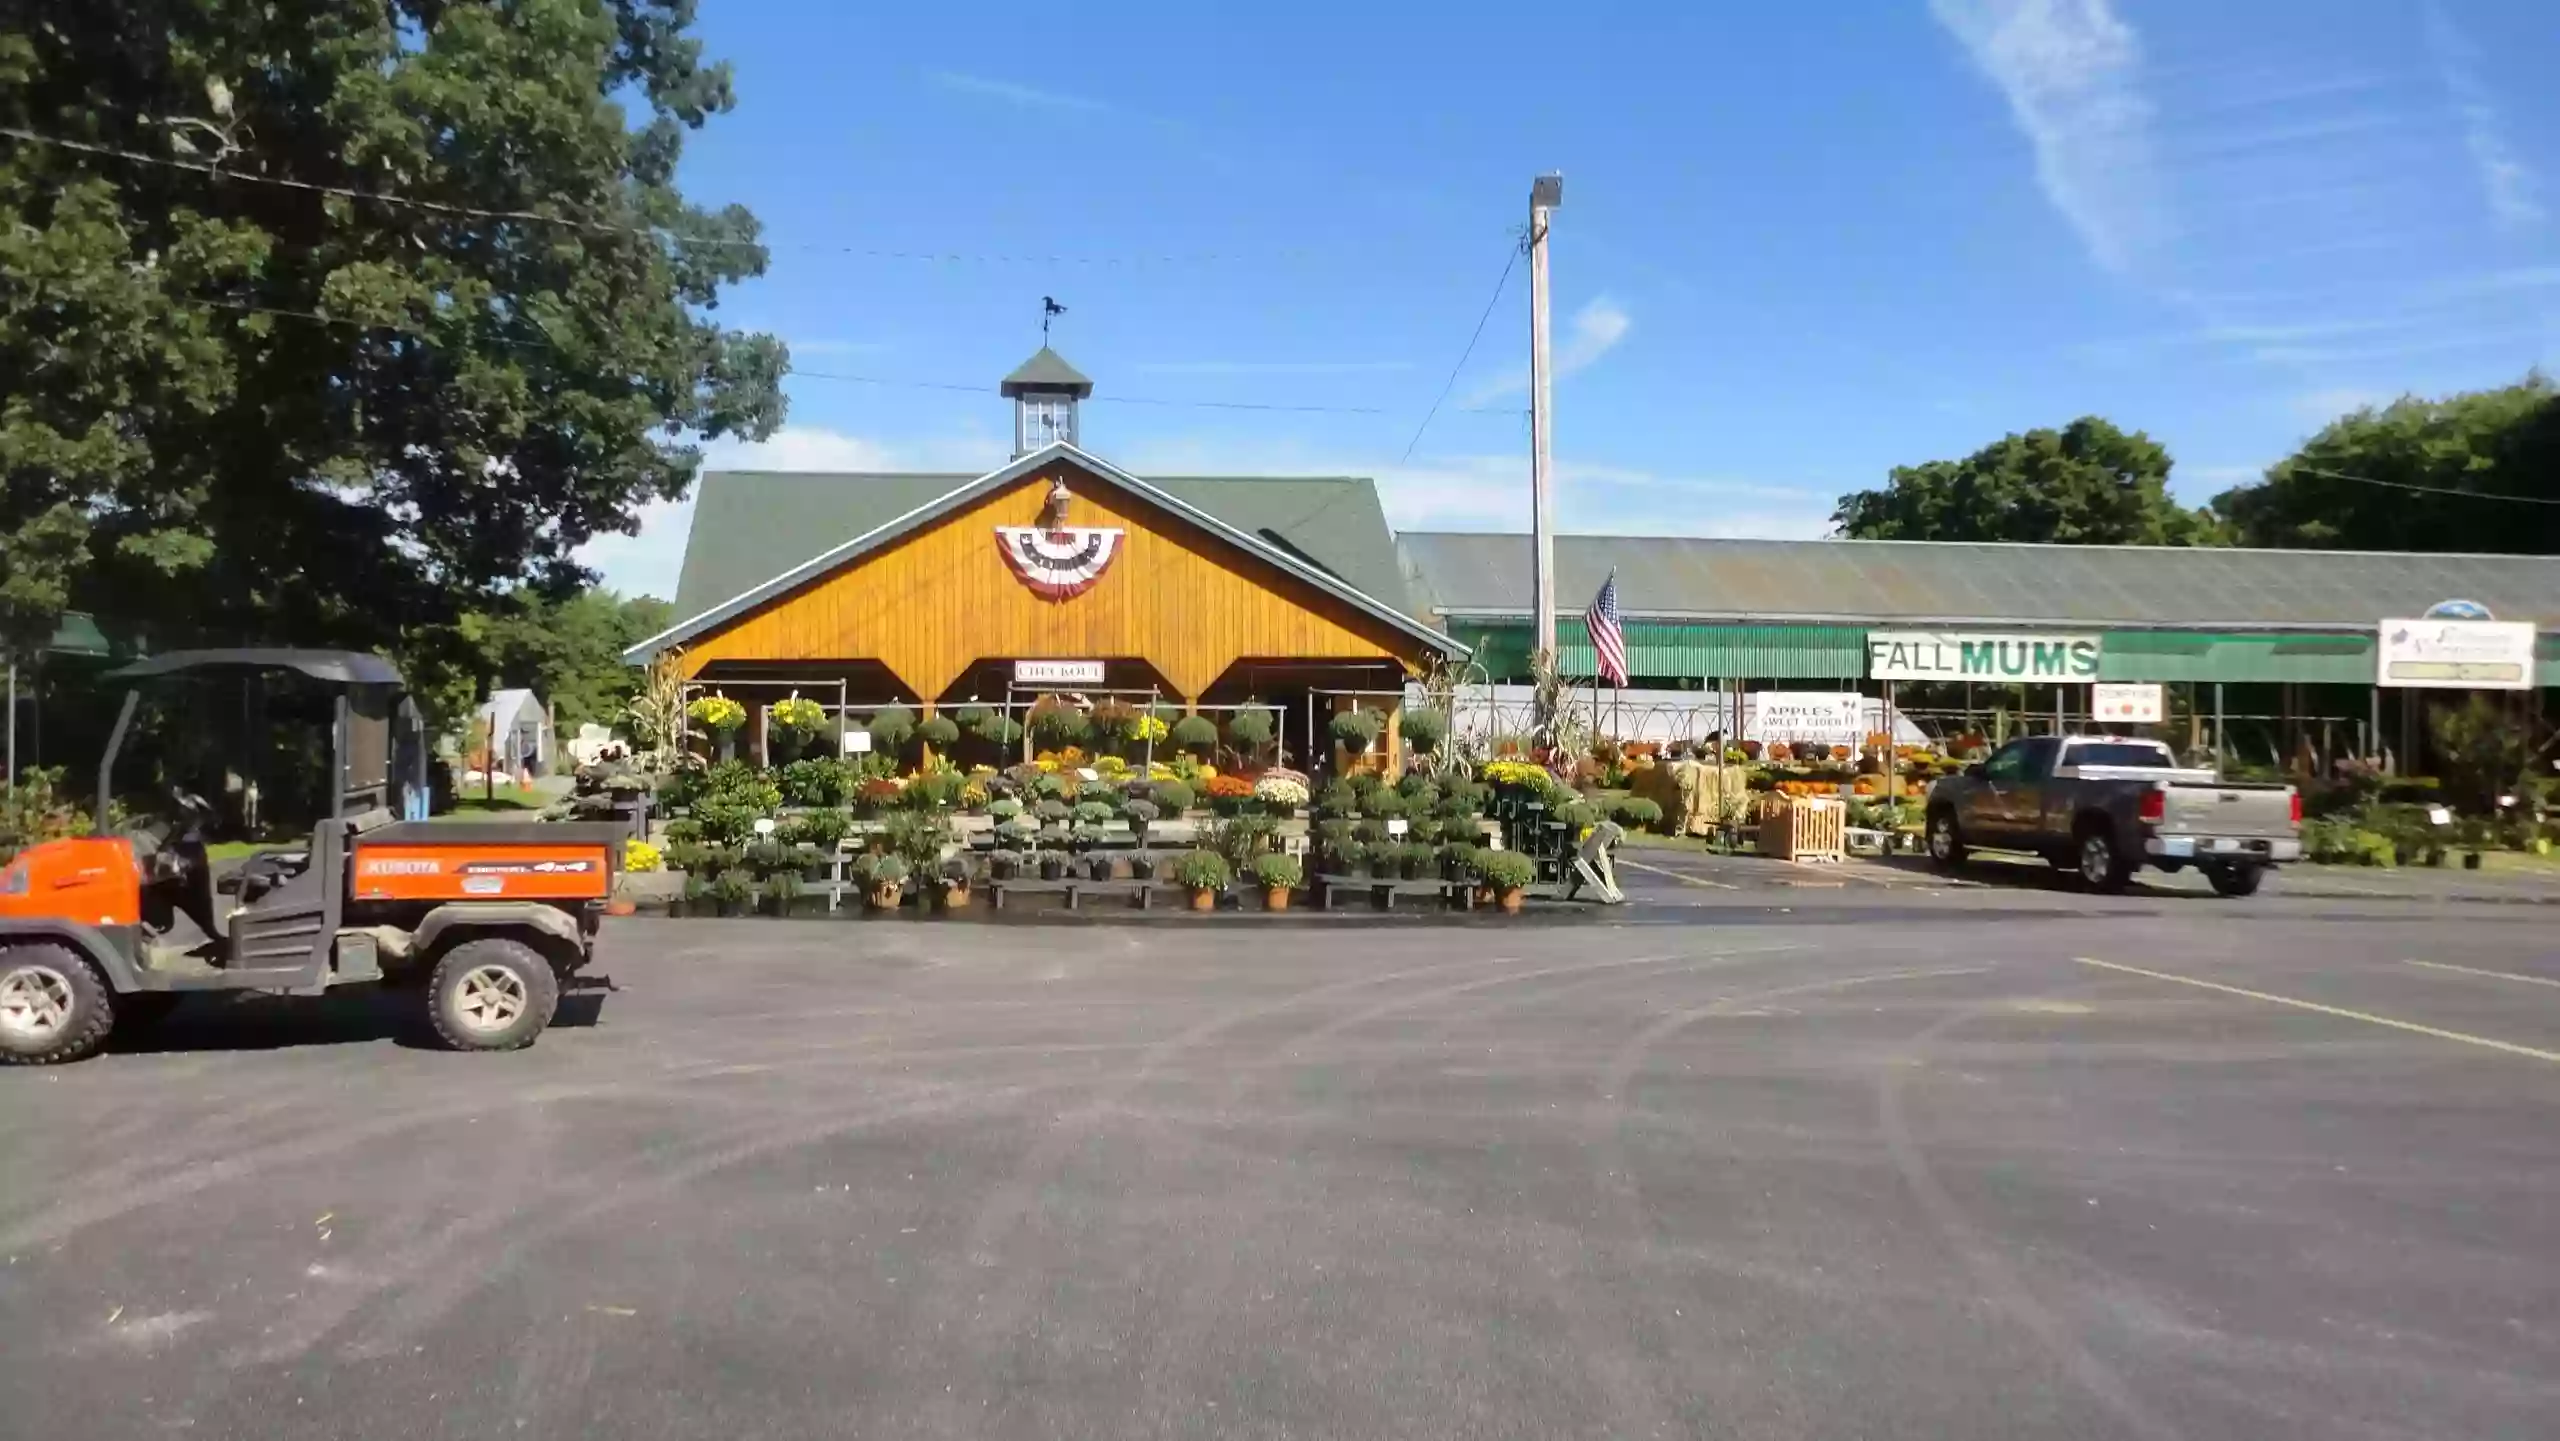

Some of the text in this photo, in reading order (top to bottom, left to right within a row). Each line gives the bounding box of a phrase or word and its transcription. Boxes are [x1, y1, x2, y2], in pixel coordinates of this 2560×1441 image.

[1870, 640, 2099, 676] FALL MUMS
[1766, 705, 1834, 716] APPLES
[367, 858, 440, 874] KUBOTA
